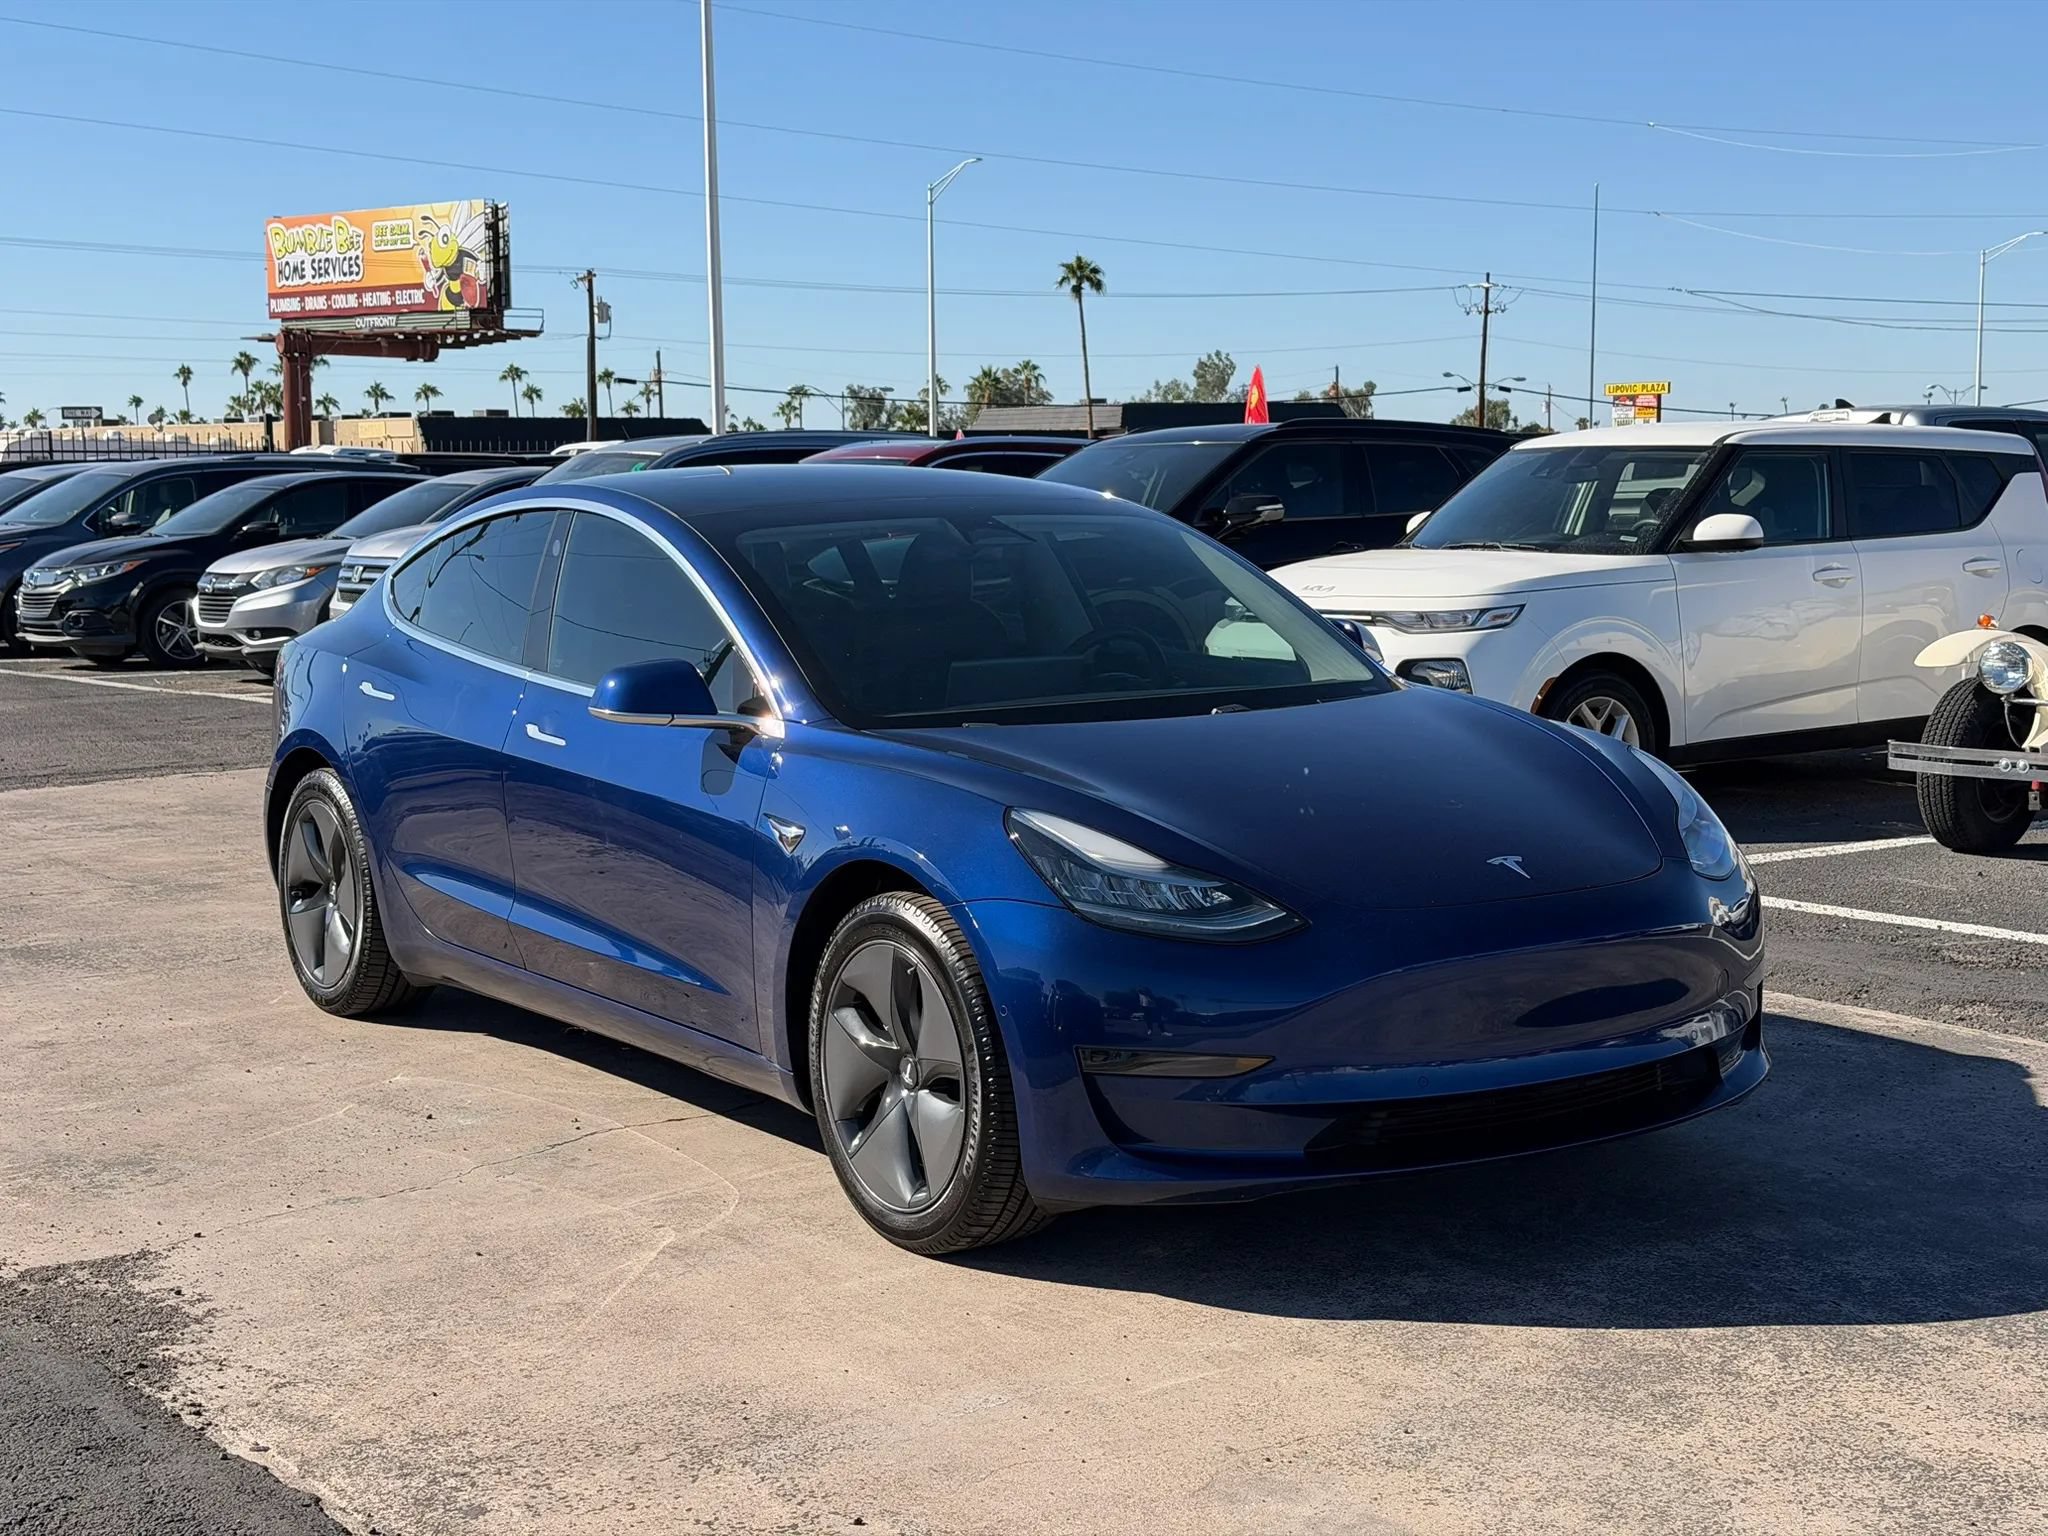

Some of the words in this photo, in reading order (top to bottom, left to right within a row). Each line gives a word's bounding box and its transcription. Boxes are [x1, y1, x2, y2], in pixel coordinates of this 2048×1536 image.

[270, 226, 333, 260] BUMBLE
[334, 219, 361, 254] BEE
[278, 259, 306, 282] HOME
[310, 254, 361, 279] SERVICES
[270, 297, 301, 312] PLUMBING
[304, 295, 328, 310] DRAINS
[331, 293, 358, 309] COOLING
[362, 291, 391, 307] HEATING
[395, 288, 425, 305] ELECTRIC
[1608, 384, 1638, 393] LIPOVIC
[1641, 383, 1666, 393] PLAZA
[964, 1081, 979, 1176] MICHELIN
